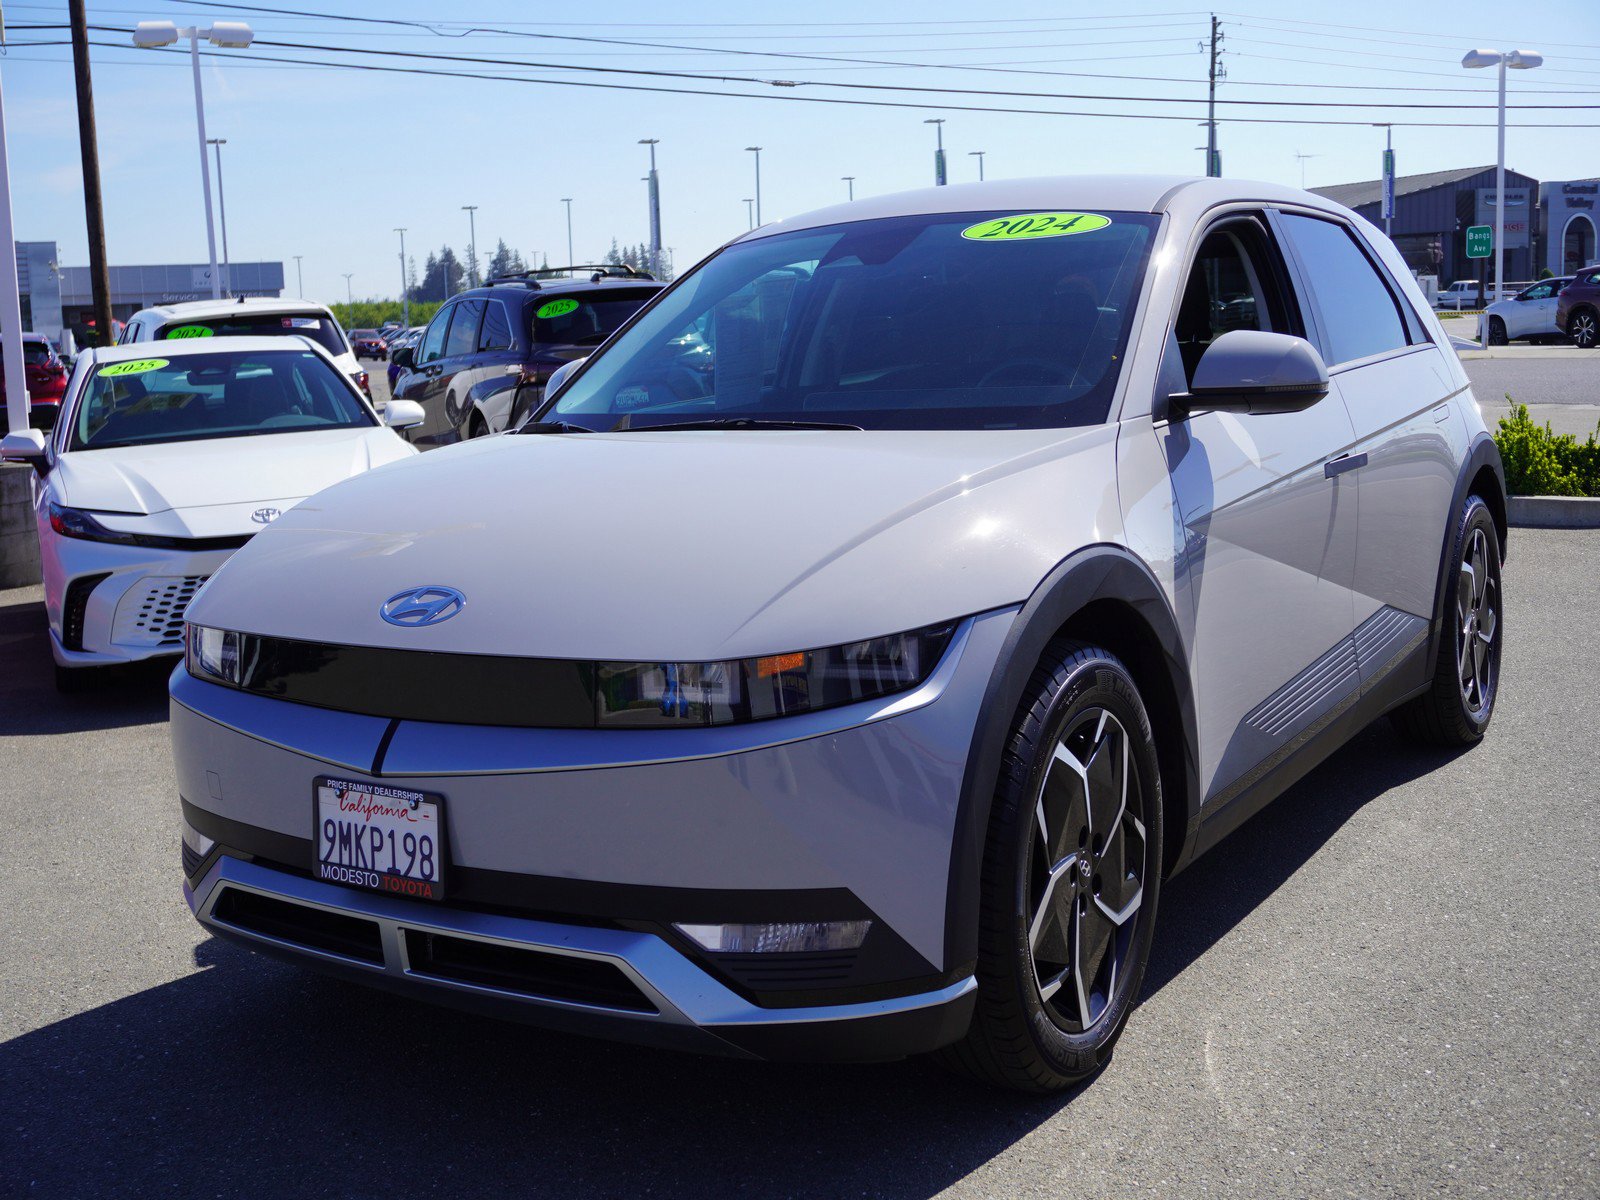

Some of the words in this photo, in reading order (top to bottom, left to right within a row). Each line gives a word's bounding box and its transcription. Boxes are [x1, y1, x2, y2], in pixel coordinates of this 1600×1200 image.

[979, 215, 1085, 238] 2024
[1468, 232, 1490, 241] Bangs
[162, 293, 198, 301] Service
[544, 300, 572, 317] 2025
[110, 359, 158, 375] 2025
[327, 779, 348, 790] PRICE
[348, 782, 373, 793] FAMILY
[374, 786, 424, 802] DEALERSHIPS
[339, 790, 417, 822] California
[323, 818, 434, 882] 9MKP198
[320, 864, 379, 888] MODESTO
[383, 876, 433, 898] TOYOTA
